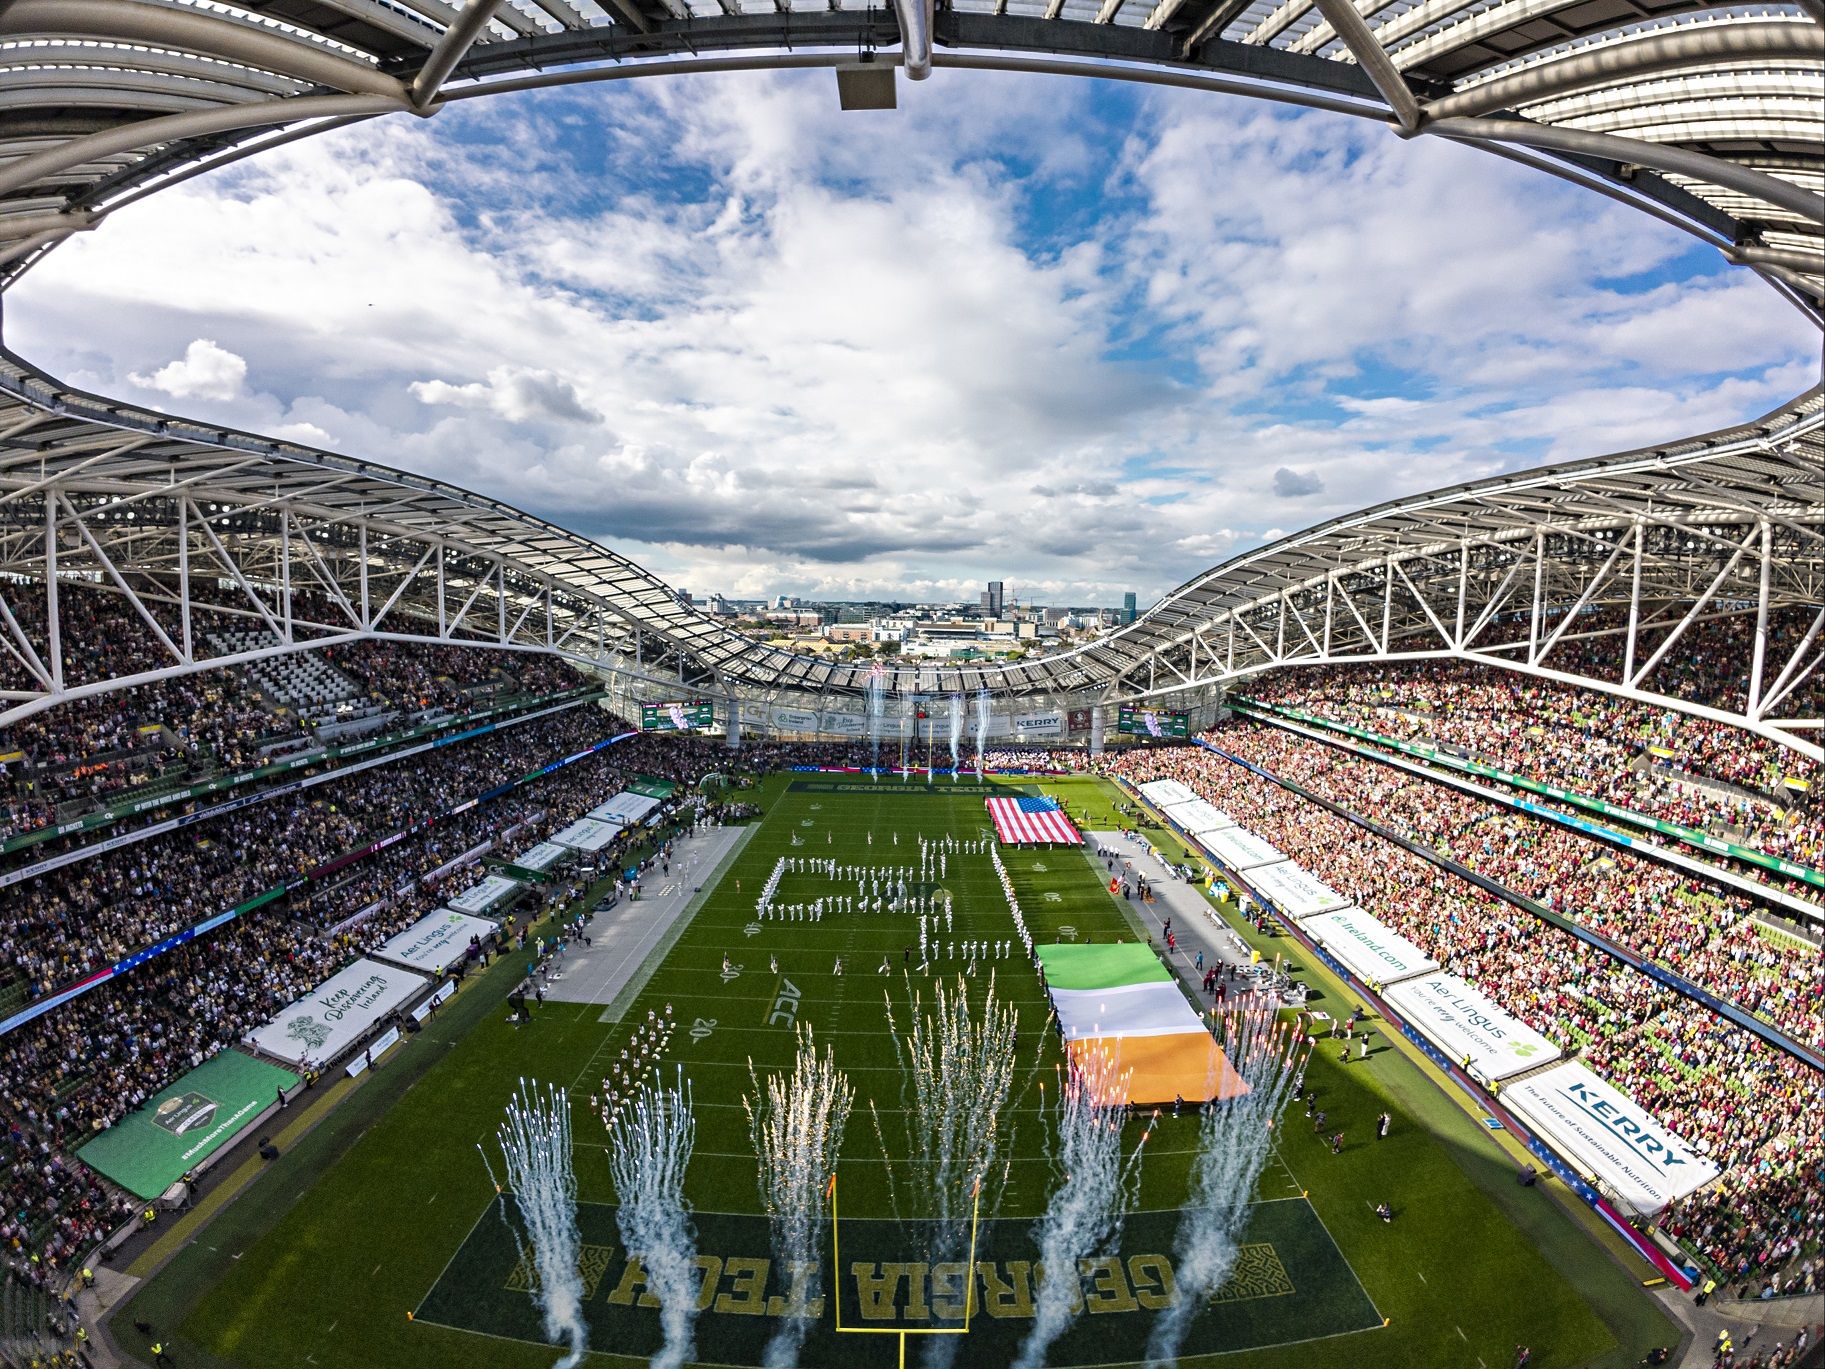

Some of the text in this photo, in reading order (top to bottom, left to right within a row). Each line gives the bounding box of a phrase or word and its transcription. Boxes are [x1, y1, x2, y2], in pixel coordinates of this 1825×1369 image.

[1017, 718, 1059, 726] KERRY
[836, 784, 928, 792] GEORGIA
[26, 864, 48, 874] KERRY
[400, 924, 452, 958] Aer Lingus
[434, 938, 450, 950] very
[1341, 922, 1408, 972] Ireland.com
[319, 988, 349, 1008] Keep
[324, 974, 388, 1021] Discovering
[358, 986, 388, 1010] Ireland
[769, 978, 802, 1030] ACC
[1426, 981, 1508, 1038] Aer Lingus
[690, 1018, 718, 1038] 20
[1410, 985, 1498, 1054] You're very welcome
[182, 1100, 258, 1160] #MuchMoreThanAGame
[1524, 1086, 1662, 1200] The Future of Sustainable Nutrition
[1568, 1082, 1687, 1167] KERRY
